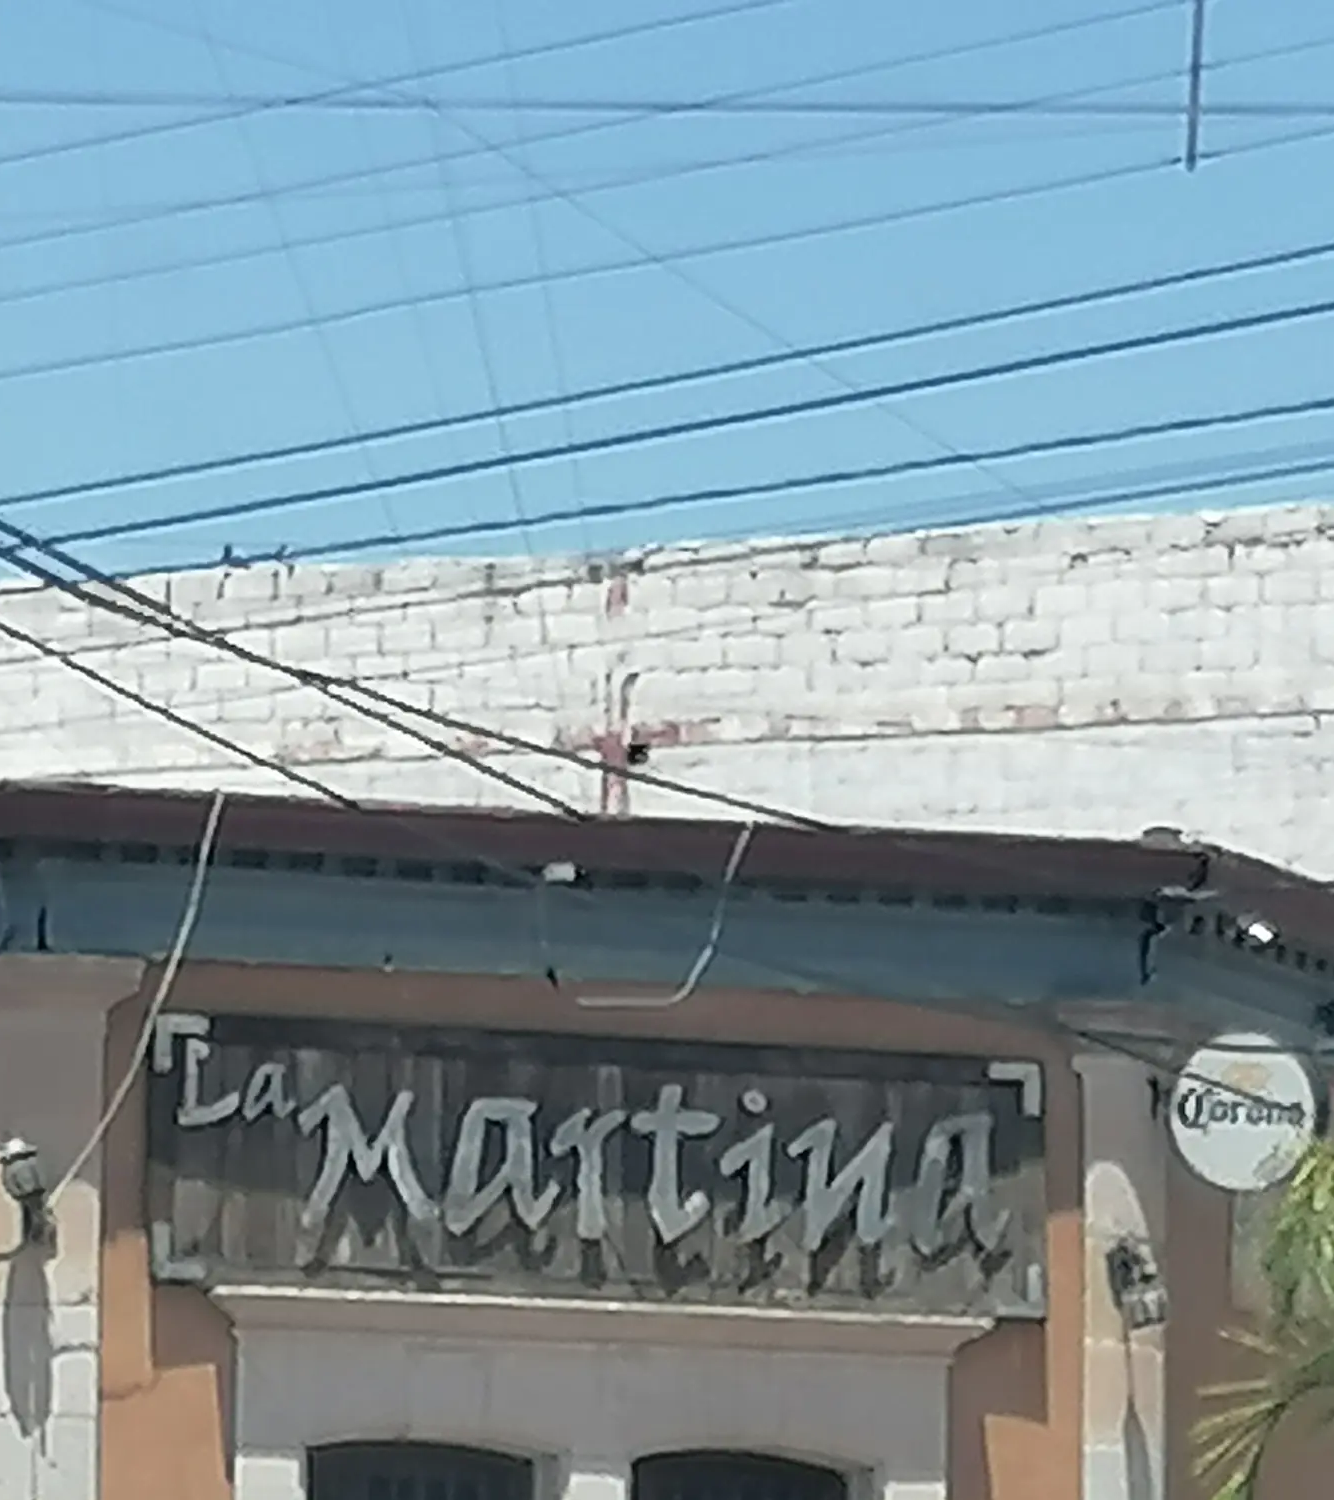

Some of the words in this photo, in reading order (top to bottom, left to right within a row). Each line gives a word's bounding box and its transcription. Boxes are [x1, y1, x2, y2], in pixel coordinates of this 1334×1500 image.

[181, 1034, 291, 1126] La
[299, 1083, 1009, 1260] Martina
[1176, 1087, 1307, 1136] Corona
